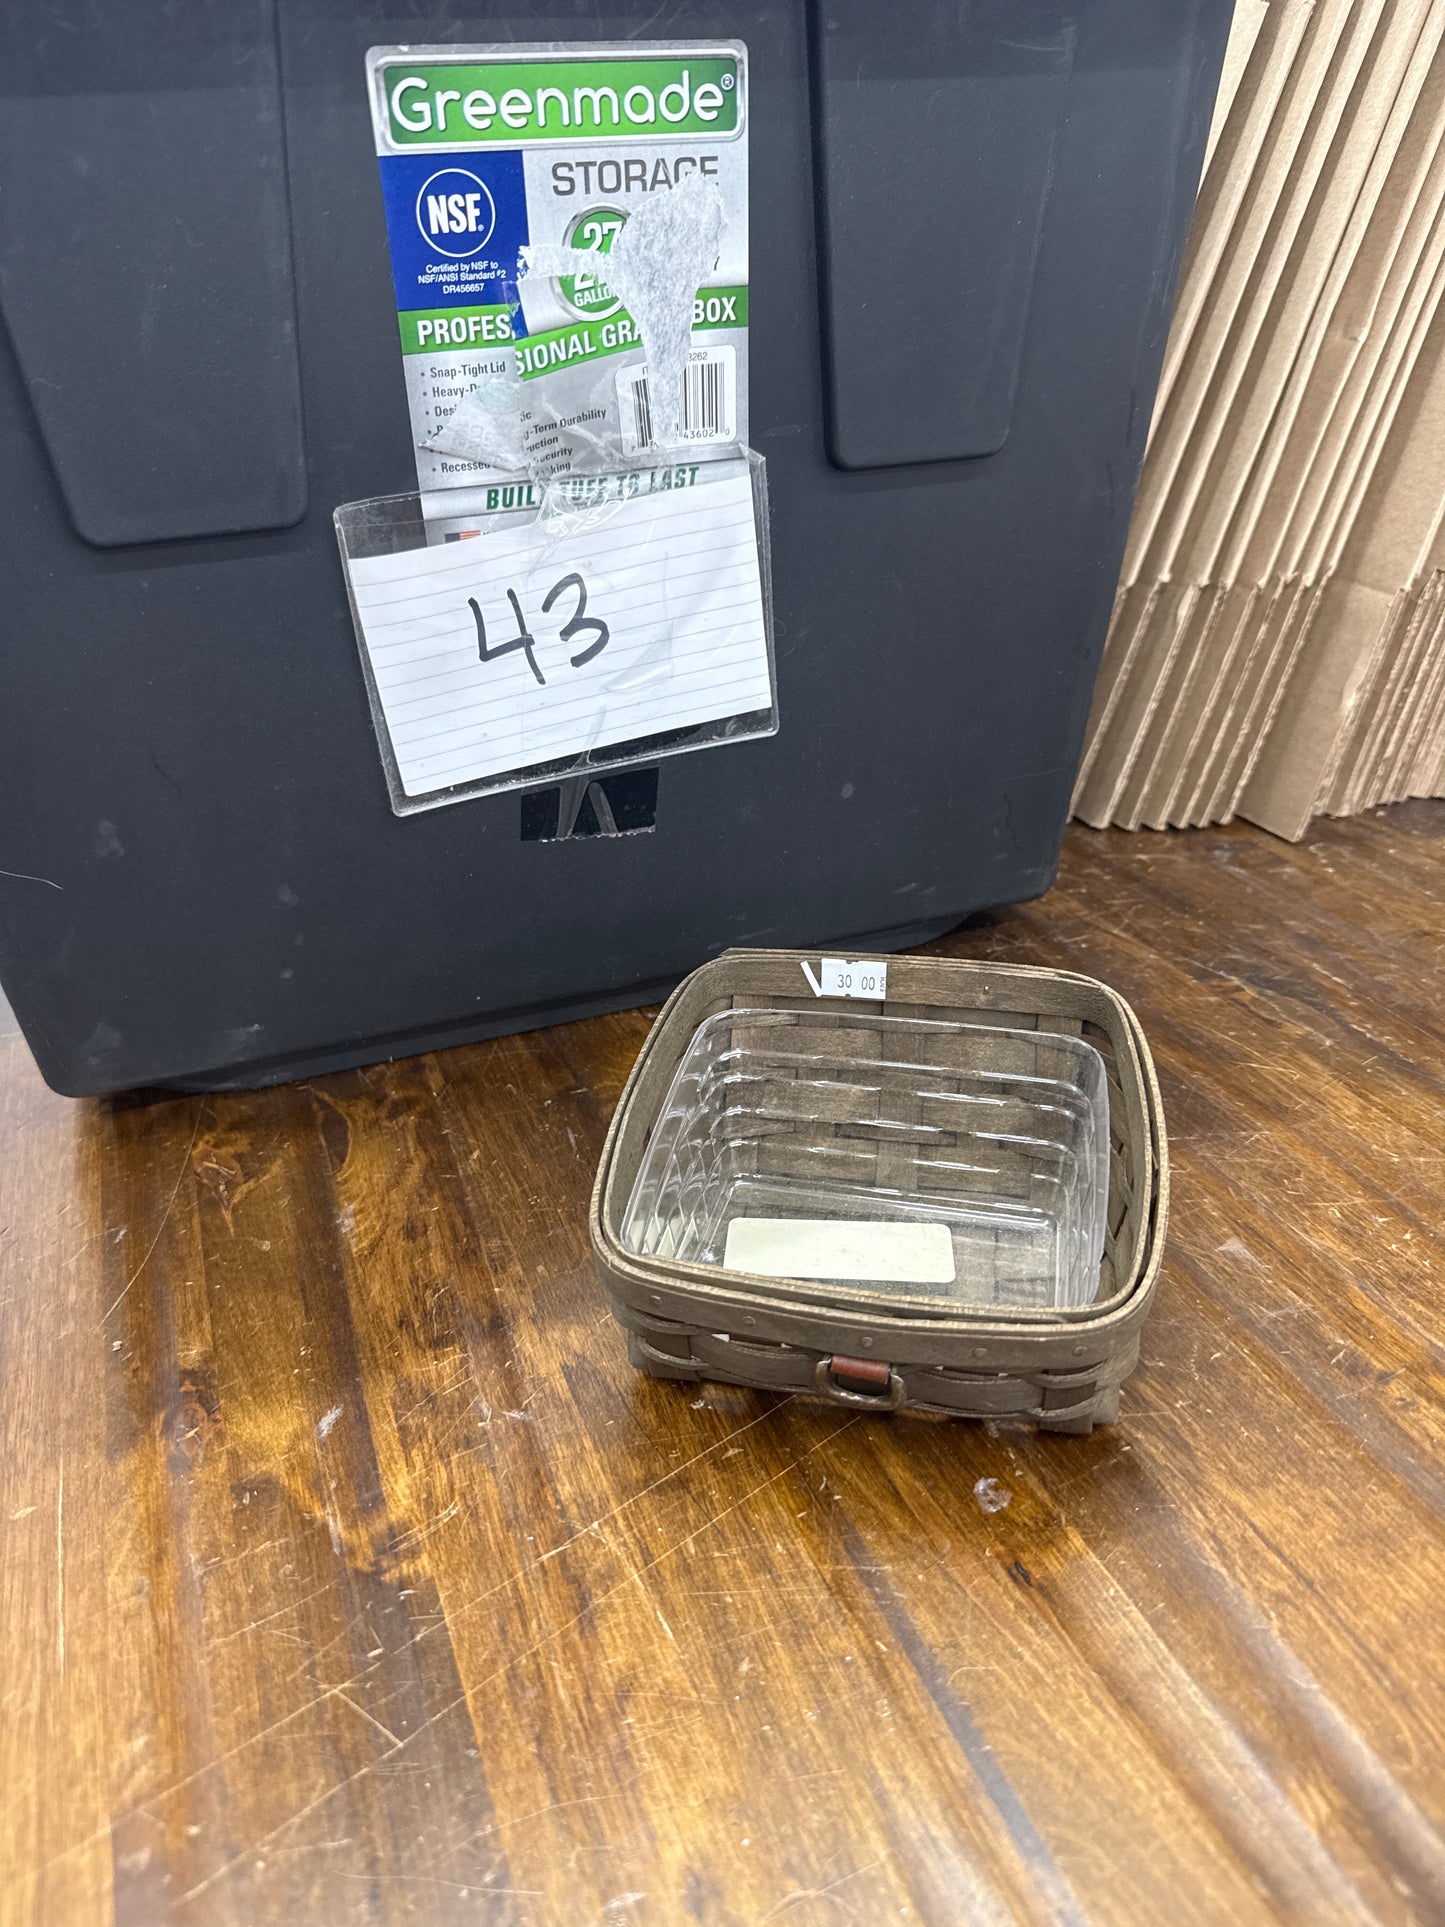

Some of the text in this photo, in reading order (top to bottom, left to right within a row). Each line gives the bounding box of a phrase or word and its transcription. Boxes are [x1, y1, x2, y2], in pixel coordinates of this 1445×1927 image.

[425, 260, 499, 274] Certified by NSF to
[417, 273, 459, 285] NSF/ANSI
[460, 270, 495, 281] Standard
[574, 285, 618, 307] GALLO
[693, 296, 737, 323] BOX
[430, 361, 506, 380] Snap-Tight Lid
[560, 408, 607, 429] Durability
[467, 572, 610, 686] 43
[837, 974, 853, 989] 30
[861, 976, 876, 991] 00
